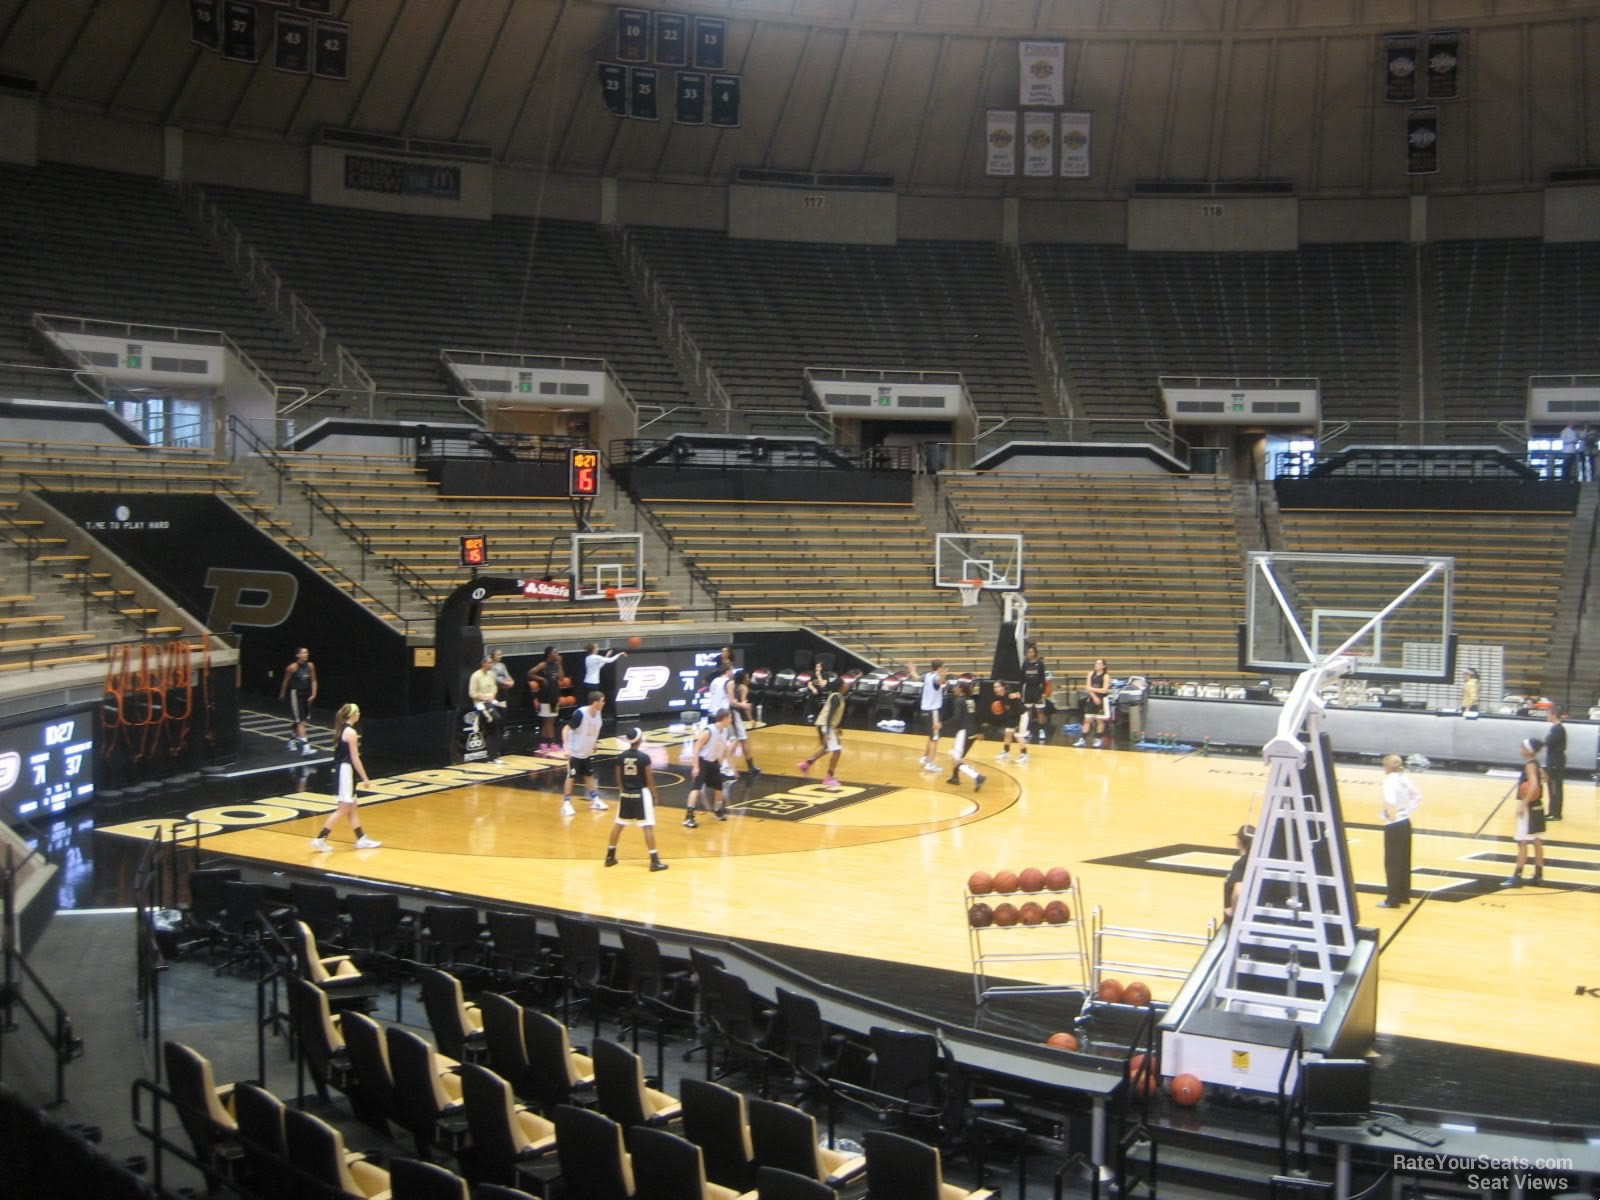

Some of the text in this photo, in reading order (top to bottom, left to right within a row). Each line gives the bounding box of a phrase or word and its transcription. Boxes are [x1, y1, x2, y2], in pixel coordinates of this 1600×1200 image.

[231, 19, 248, 33] 37
[625, 25, 641, 37] 10
[284, 32, 302, 45] 43
[663, 29, 679, 42] 22
[703, 33, 718, 46] 13
[323, 39, 341, 52] 42
[605, 79, 620, 92] 23
[638, 83, 652, 96] 25
[682, 87, 698, 100] 33
[720, 91, 730, 103] 4
[804, 196, 825, 208] 117
[1203, 206, 1222, 217] 118
[123, 521, 145, 529] PLAY
[148, 520, 171, 529] HARD
[615, 665, 671, 702] P
[65, 754, 83, 776] 37
